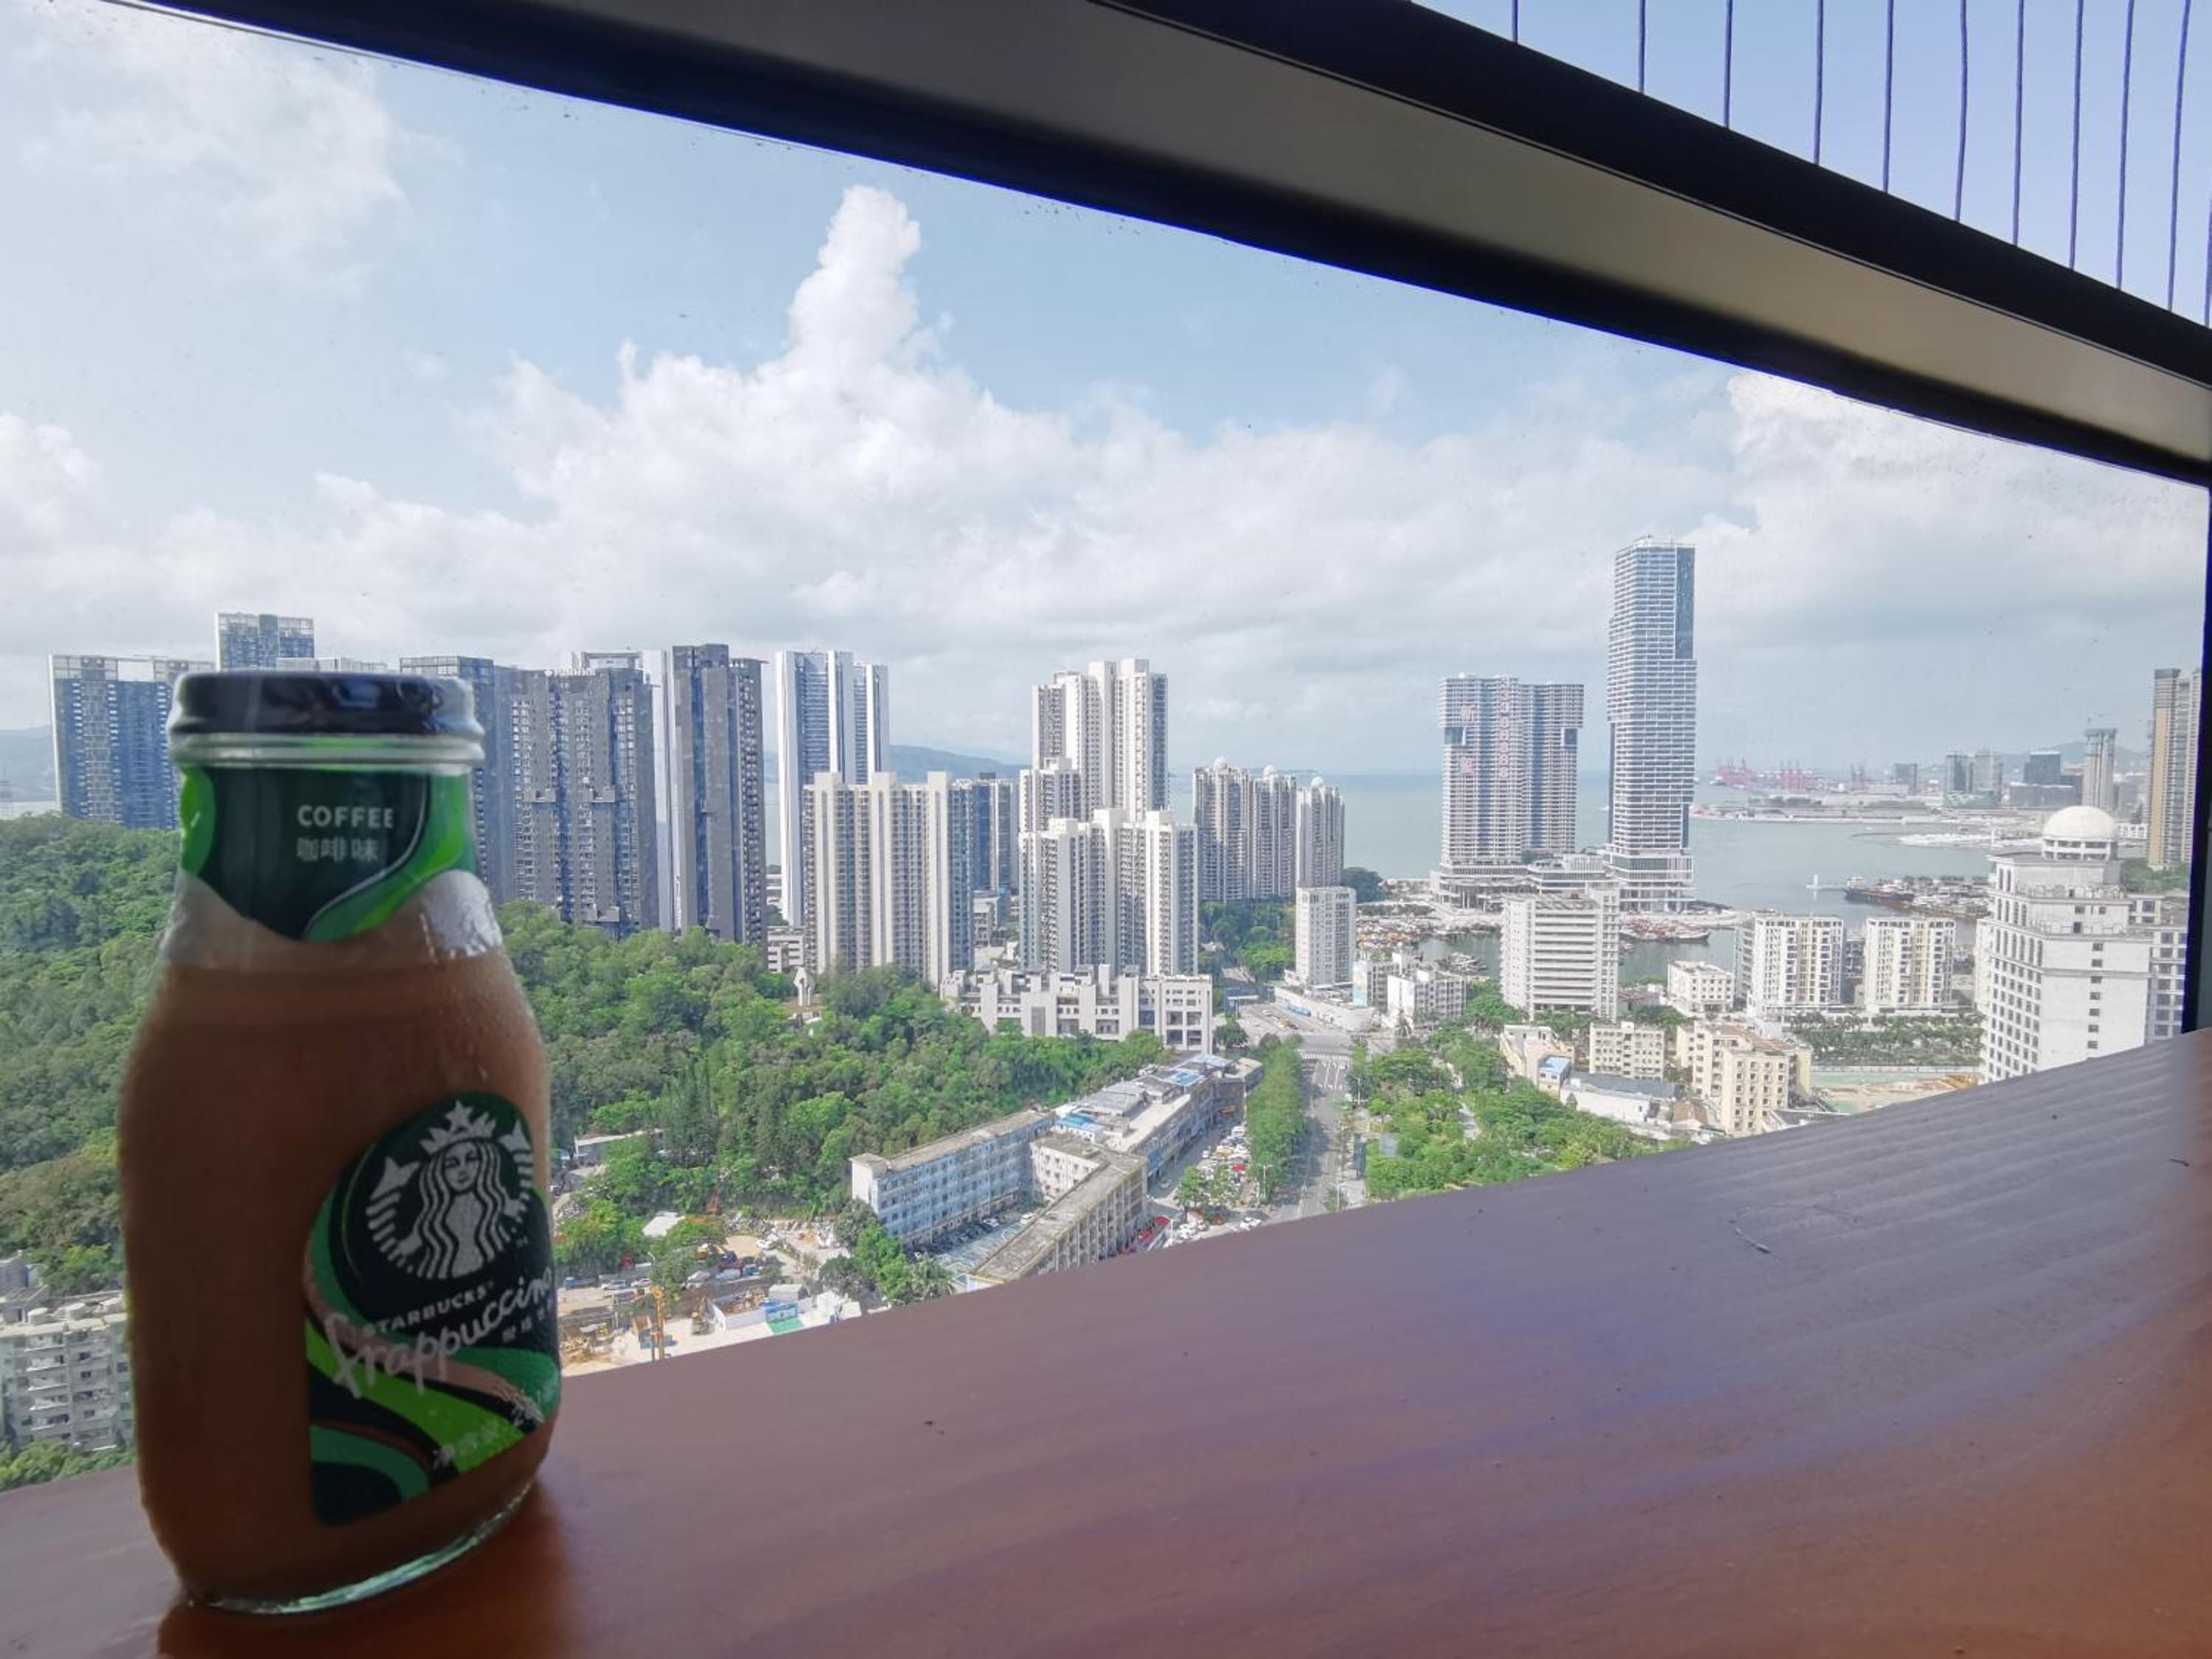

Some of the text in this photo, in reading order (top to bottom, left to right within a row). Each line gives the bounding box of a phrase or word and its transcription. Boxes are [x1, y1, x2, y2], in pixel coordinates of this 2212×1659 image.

[297, 804, 394, 827] COFFEE
[296, 837, 378, 861] 咖啡味
[362, 1284, 487, 1338] STARBUCKS
